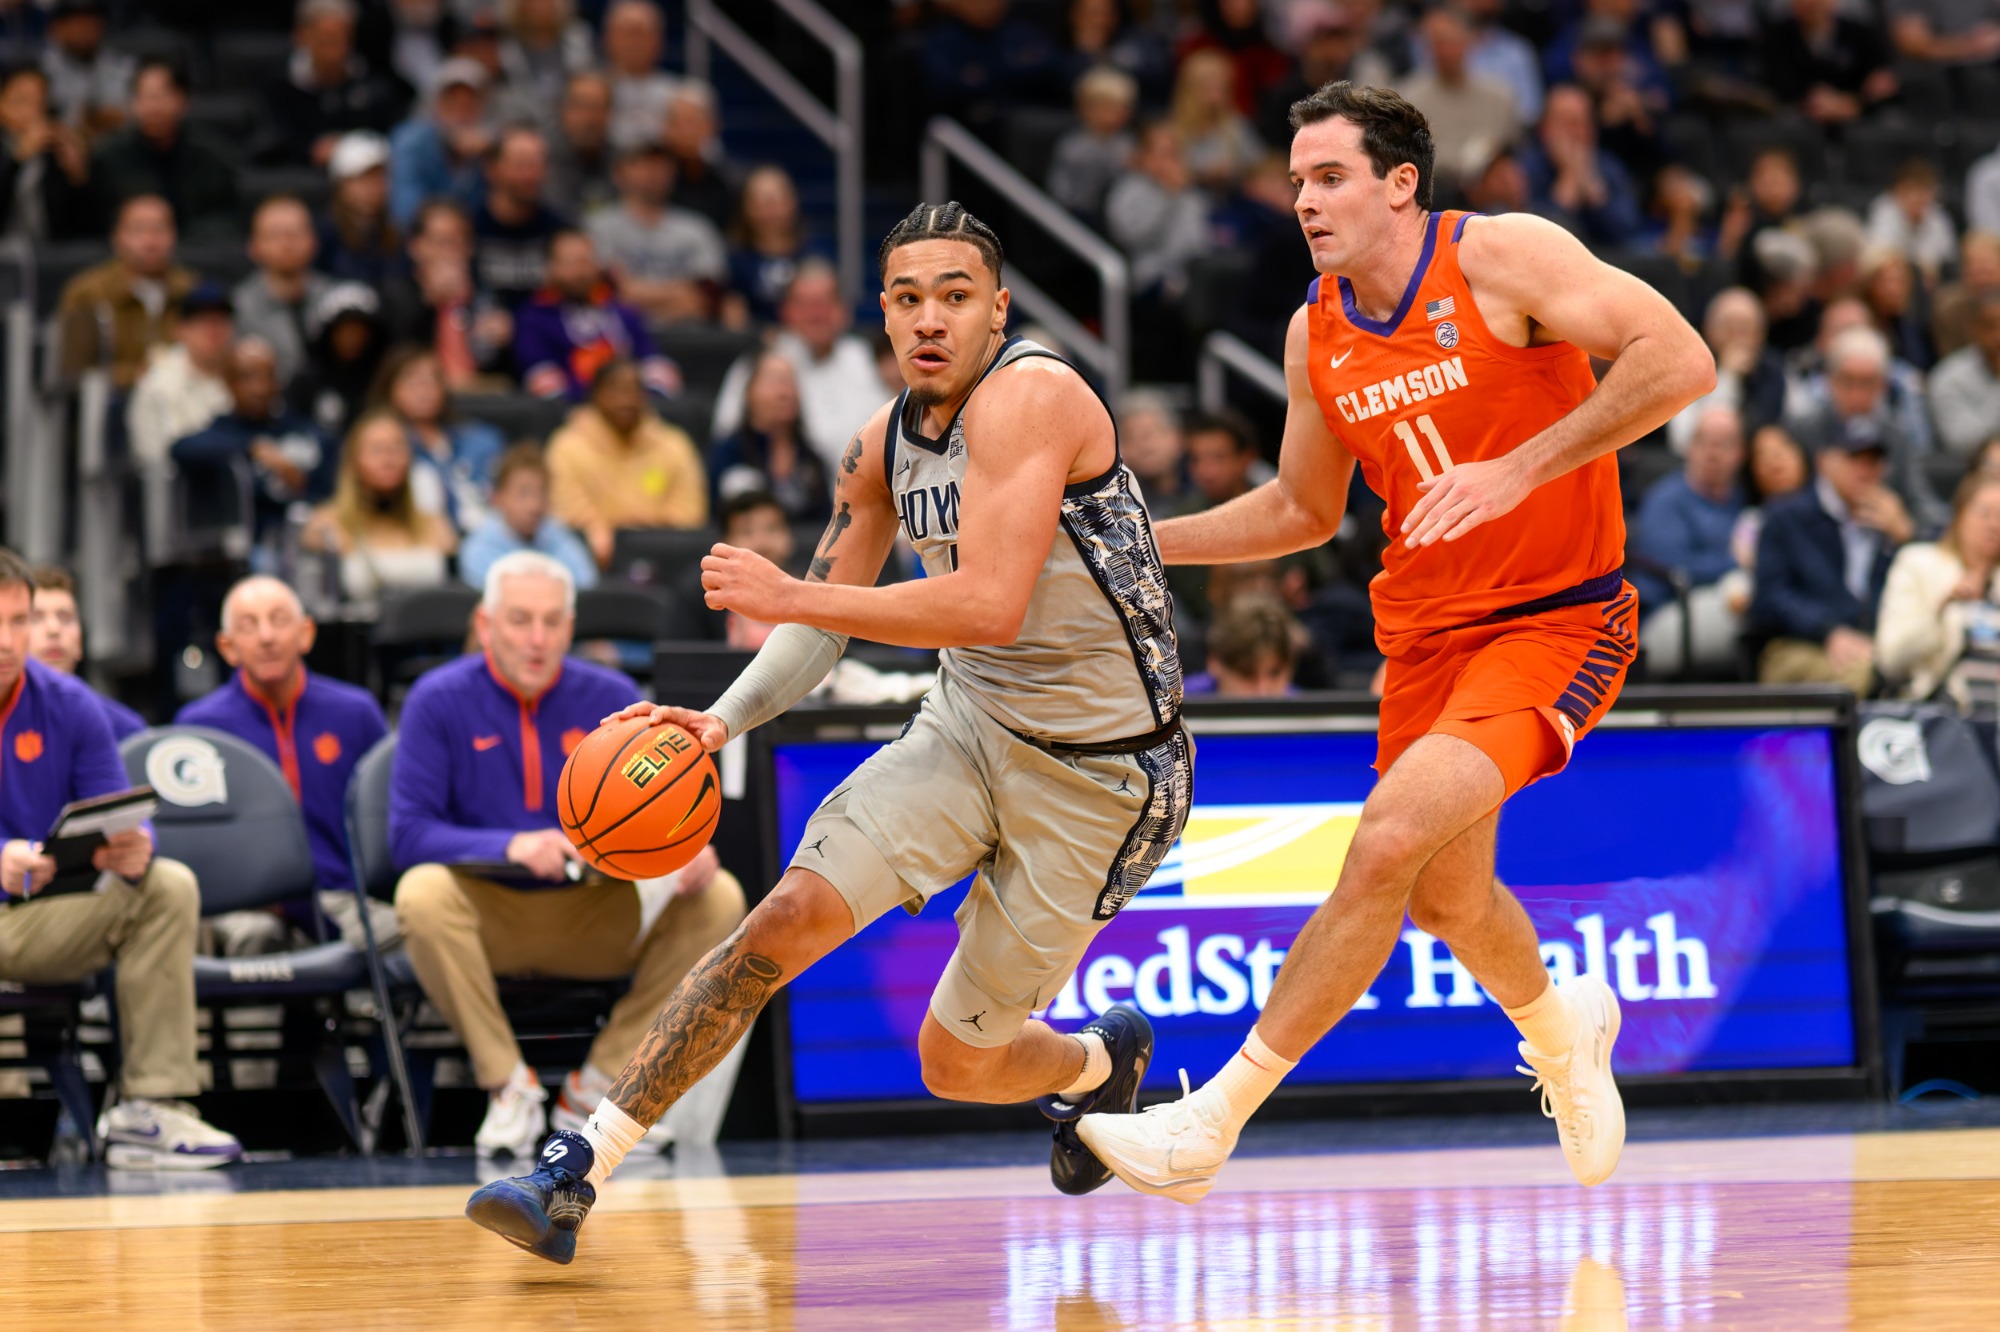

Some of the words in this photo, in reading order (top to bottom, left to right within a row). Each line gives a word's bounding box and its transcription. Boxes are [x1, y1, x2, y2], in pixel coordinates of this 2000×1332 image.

[1440, 328, 1456, 339] ACC
[1335, 356, 1469, 424] CLEMSON
[949, 445, 964, 457] EAST
[1393, 414, 1455, 482] 11
[626, 732, 692, 791] ELITE
[1031, 925, 1381, 1020] edSt
[1401, 911, 1718, 1008] Halth
